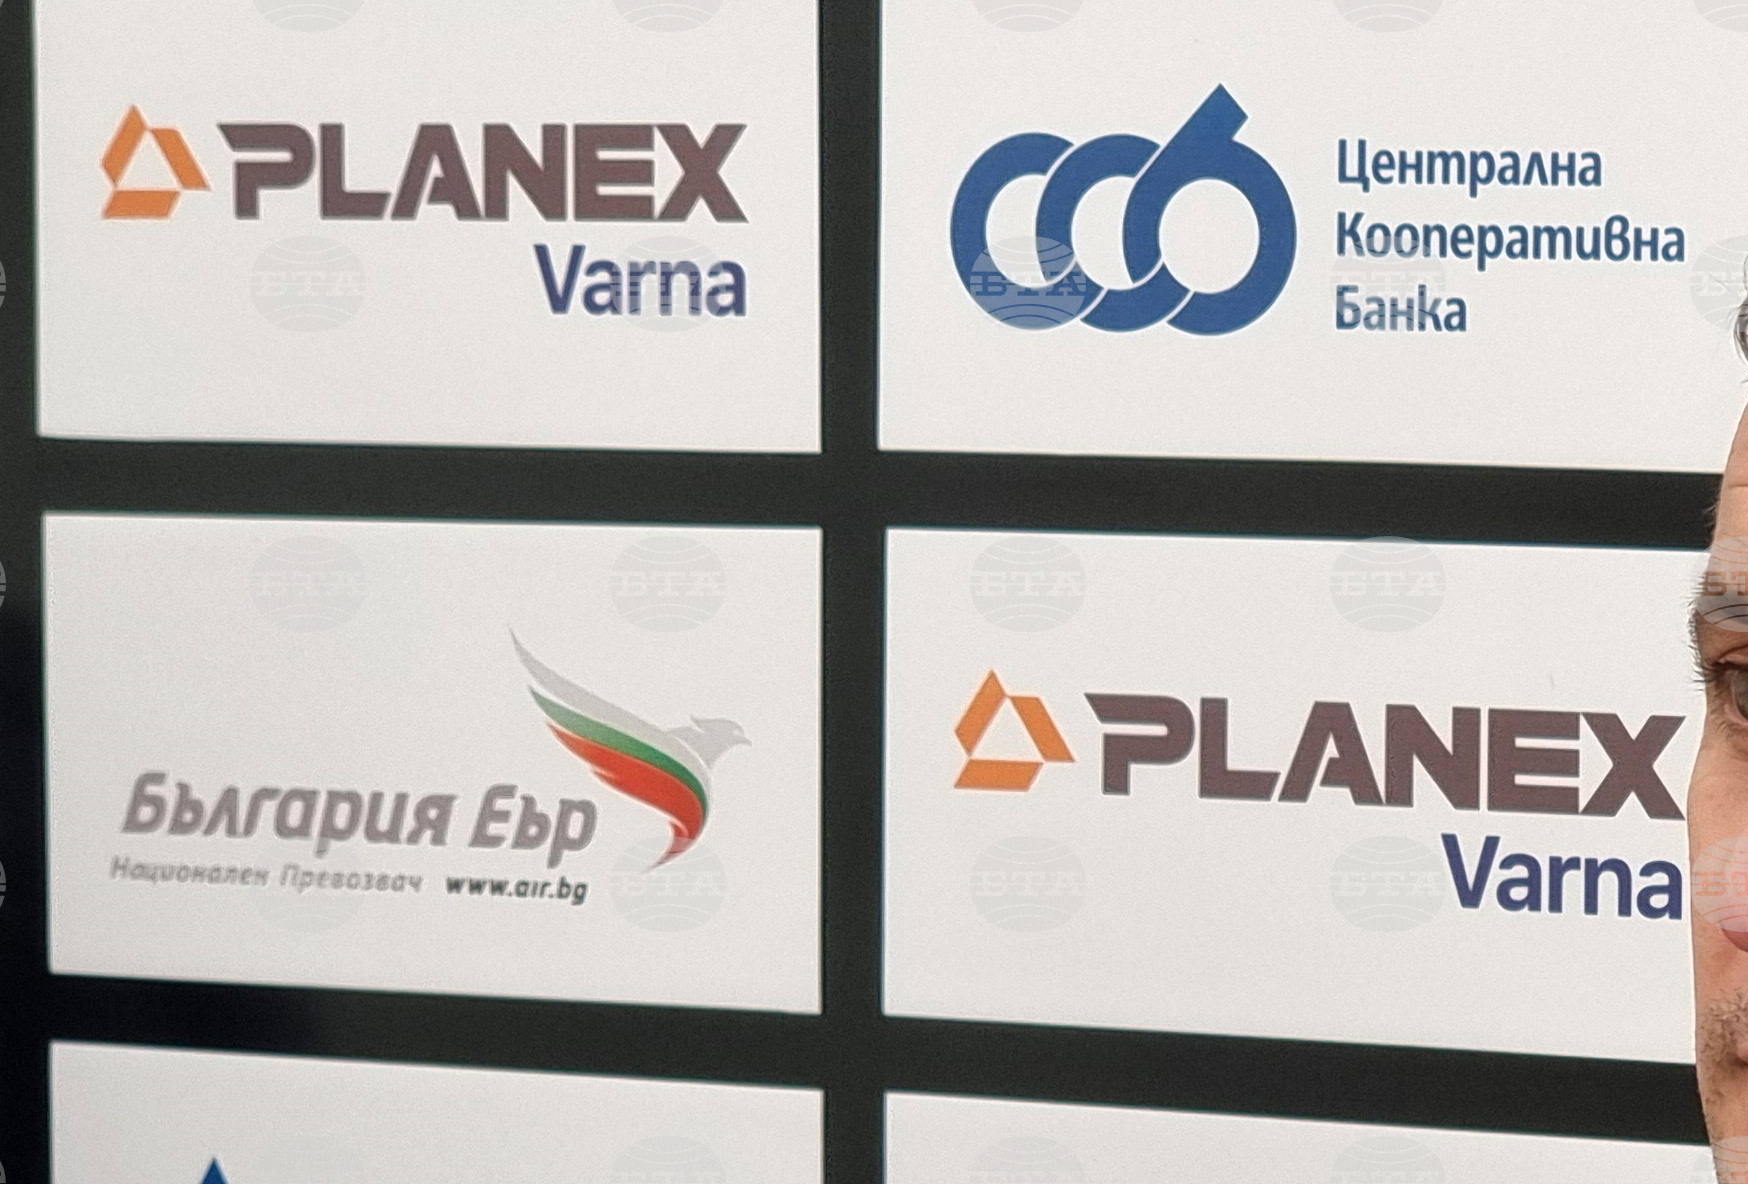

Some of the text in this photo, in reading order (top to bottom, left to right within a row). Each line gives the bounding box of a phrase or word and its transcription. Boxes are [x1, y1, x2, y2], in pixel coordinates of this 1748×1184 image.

[217, 123, 748, 223] PLANEX
[1338, 139, 1602, 197] Централна
[1337, 211, 1685, 271] Кооперативна
[534, 243, 746, 316] Varna
[1336, 285, 1467, 332] Банка
[1084, 692, 1687, 820] PLANEX
[122, 772, 597, 869] България Еър
[110, 856, 270, 888] Национален
[446, 876, 588, 905] www.air.bg
[1440, 833, 1683, 919] Varna
